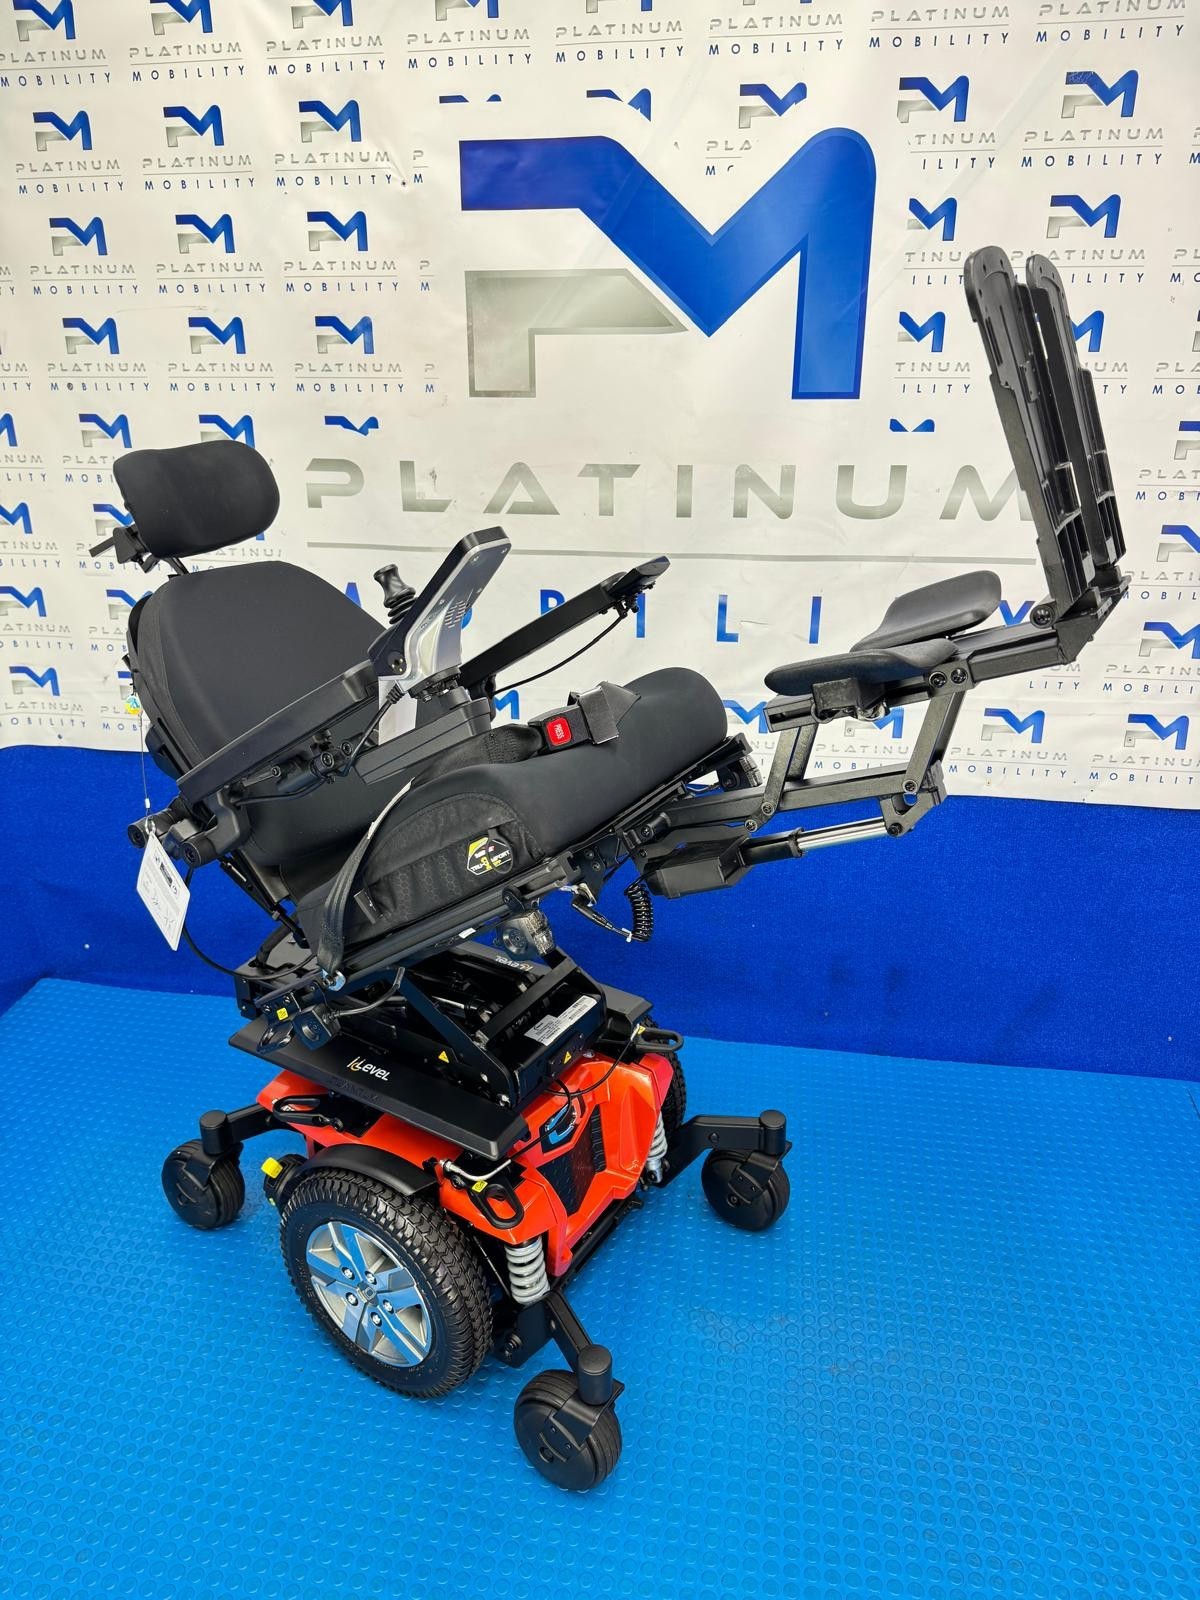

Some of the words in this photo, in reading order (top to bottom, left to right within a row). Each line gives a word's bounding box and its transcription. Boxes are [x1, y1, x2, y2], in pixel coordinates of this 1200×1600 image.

[872, 6, 1010, 22] PLATINUM
[1039, 0, 1187, 17] PLATINUM
[555, 20, 683, 38] PLATINUM
[709, 13, 843, 31] PLATINUM
[407, 28, 531, 45] PLATINUM
[869, 32, 1009, 48] MOBILITY
[1036, 25, 1184, 42] MOBILITY
[129, 41, 243, 58] PLATINUM
[266, 34, 383, 53] PLATINUM
[708, 39, 843, 56] MOBILITY
[0, 49, 107, 63] PLATINUM
[407, 53, 532, 69] MOBILITY
[556, 46, 684, 63] MOBILITY
[132, 65, 246, 82] MOBILITY
[268, 60, 386, 76] MOBILITY
[0, 72, 112, 87] MOBILITY
[908, 132, 996, 146] TINUM
[1024, 127, 1164, 143] PLATINUM
[15, 159, 121, 173] PLATINUM
[142, 154, 252, 169] PLATINUM
[274, 151, 391, 166] PLATINUM
[1021, 153, 1163, 168] MOBILITY
[18, 181, 125, 195] MOBILITY
[144, 177, 256, 191] MOBILITY
[277, 174, 393, 187] MOBILITY
[1011, 249, 1146, 261] PATINUM
[29, 263, 136, 276] PLATINUM
[156, 262, 264, 275] PLATINUM
[284, 260, 398, 273] PLATINUM
[33, 284, 139, 295] MOBILITY
[158, 282, 267, 294] MOBILITY
[286, 281, 399, 293] MOBILITY
[47, 362, 147, 374] PLATINUM
[168, 362, 274, 374] PLATINUM
[294, 362, 403, 374] PLATINUM
[50, 382, 151, 392] MOBILITY
[170, 382, 277, 392] MOBILITY
[296, 382, 404, 393] MOBILITY
[304, 457, 1034, 521] PLATINUM
[0, 717, 86, 728] OBILITY
[553, 723, 566, 741] PRESS
[950, 745, 1067, 763] PLATINUM
[1092, 754, 1200, 768] PLATINU
[949, 763, 1067, 779] MOBILITY
